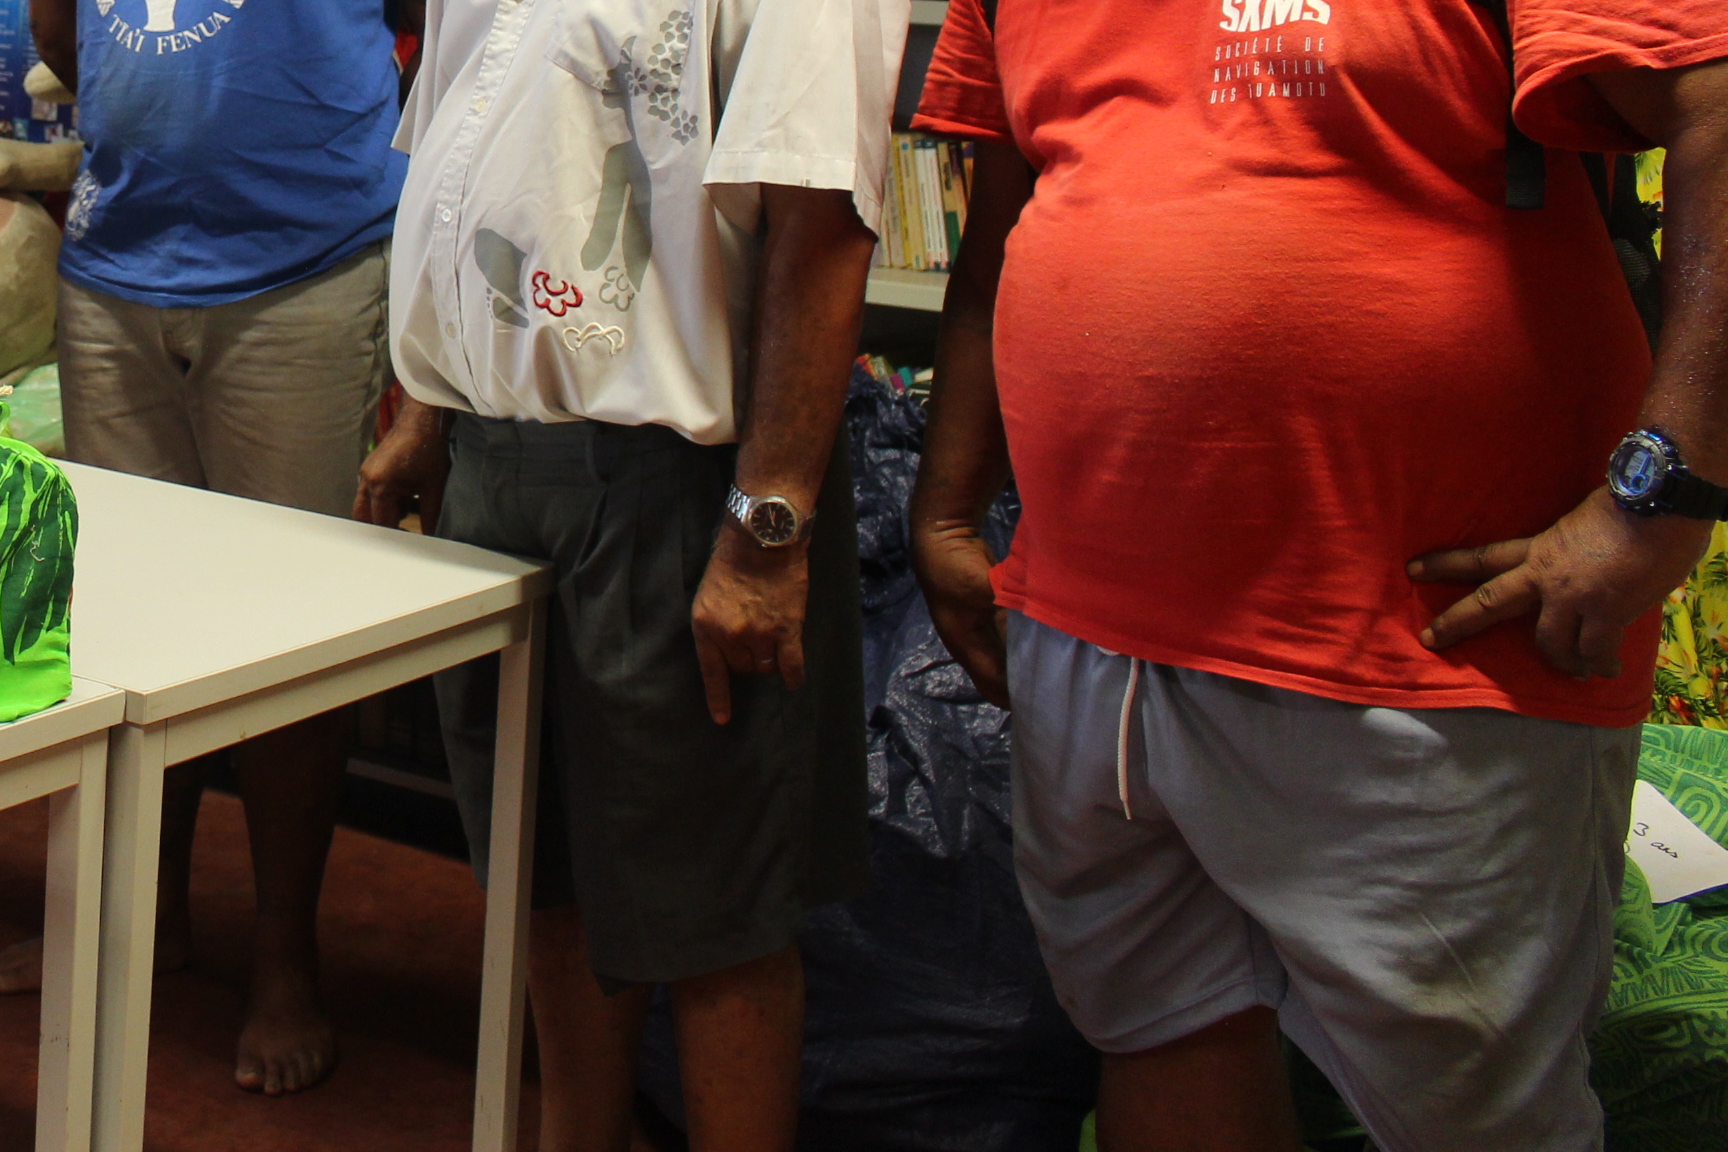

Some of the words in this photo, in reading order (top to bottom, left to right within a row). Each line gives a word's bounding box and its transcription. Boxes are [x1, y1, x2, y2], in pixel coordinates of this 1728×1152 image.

[156, 11, 232, 55] FENUA
[1214, 34, 1283, 62] SOCIÉTÉ
[1304, 36, 1325, 52] DE
[1213, 59, 1325, 83] NAVIGATION
[1210, 87, 1237, 104] DES
[1247, 81, 1326, 99] TUAMOTU
